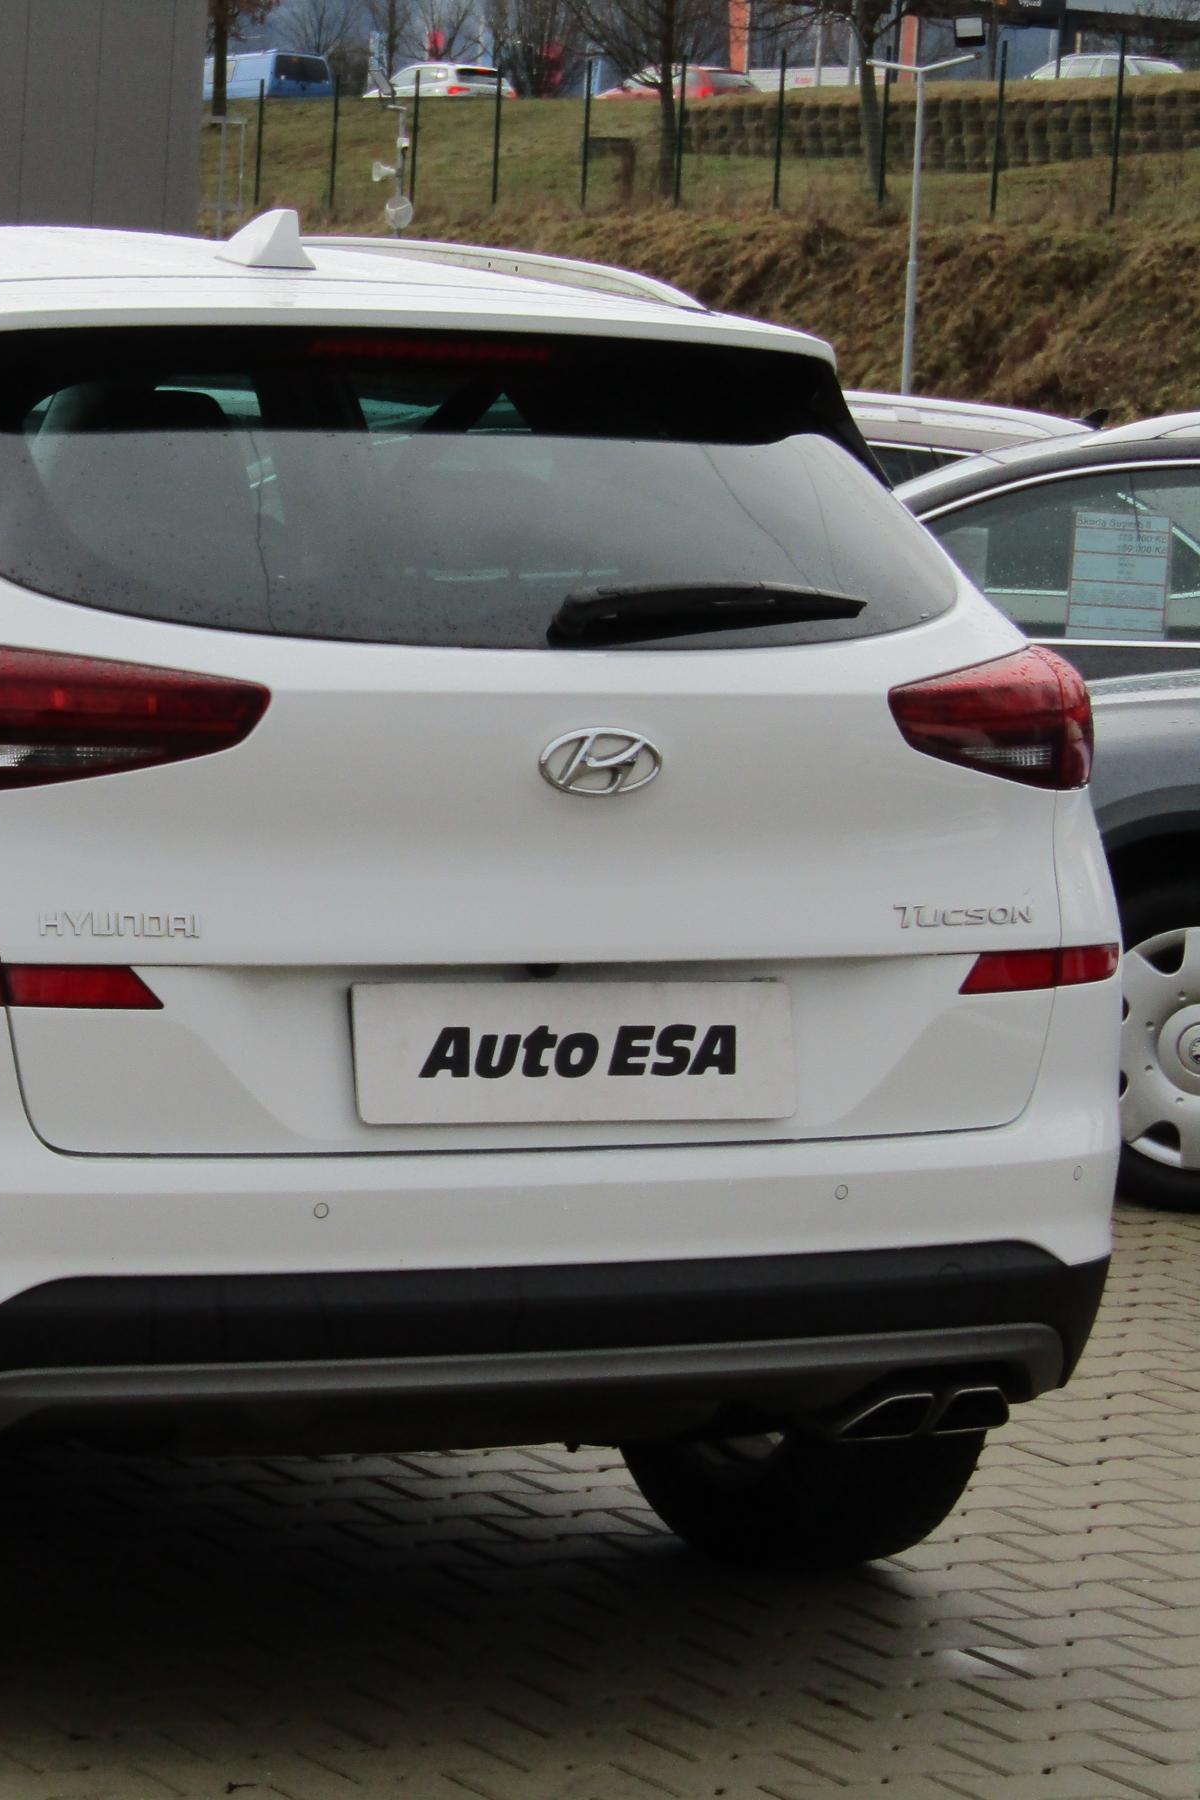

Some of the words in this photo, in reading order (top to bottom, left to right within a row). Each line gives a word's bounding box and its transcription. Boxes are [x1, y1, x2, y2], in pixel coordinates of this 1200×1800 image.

[38, 911, 200, 938] HYUNDAI
[418, 1025, 599, 1078] Auto
[607, 1024, 736, 1077] ESA
